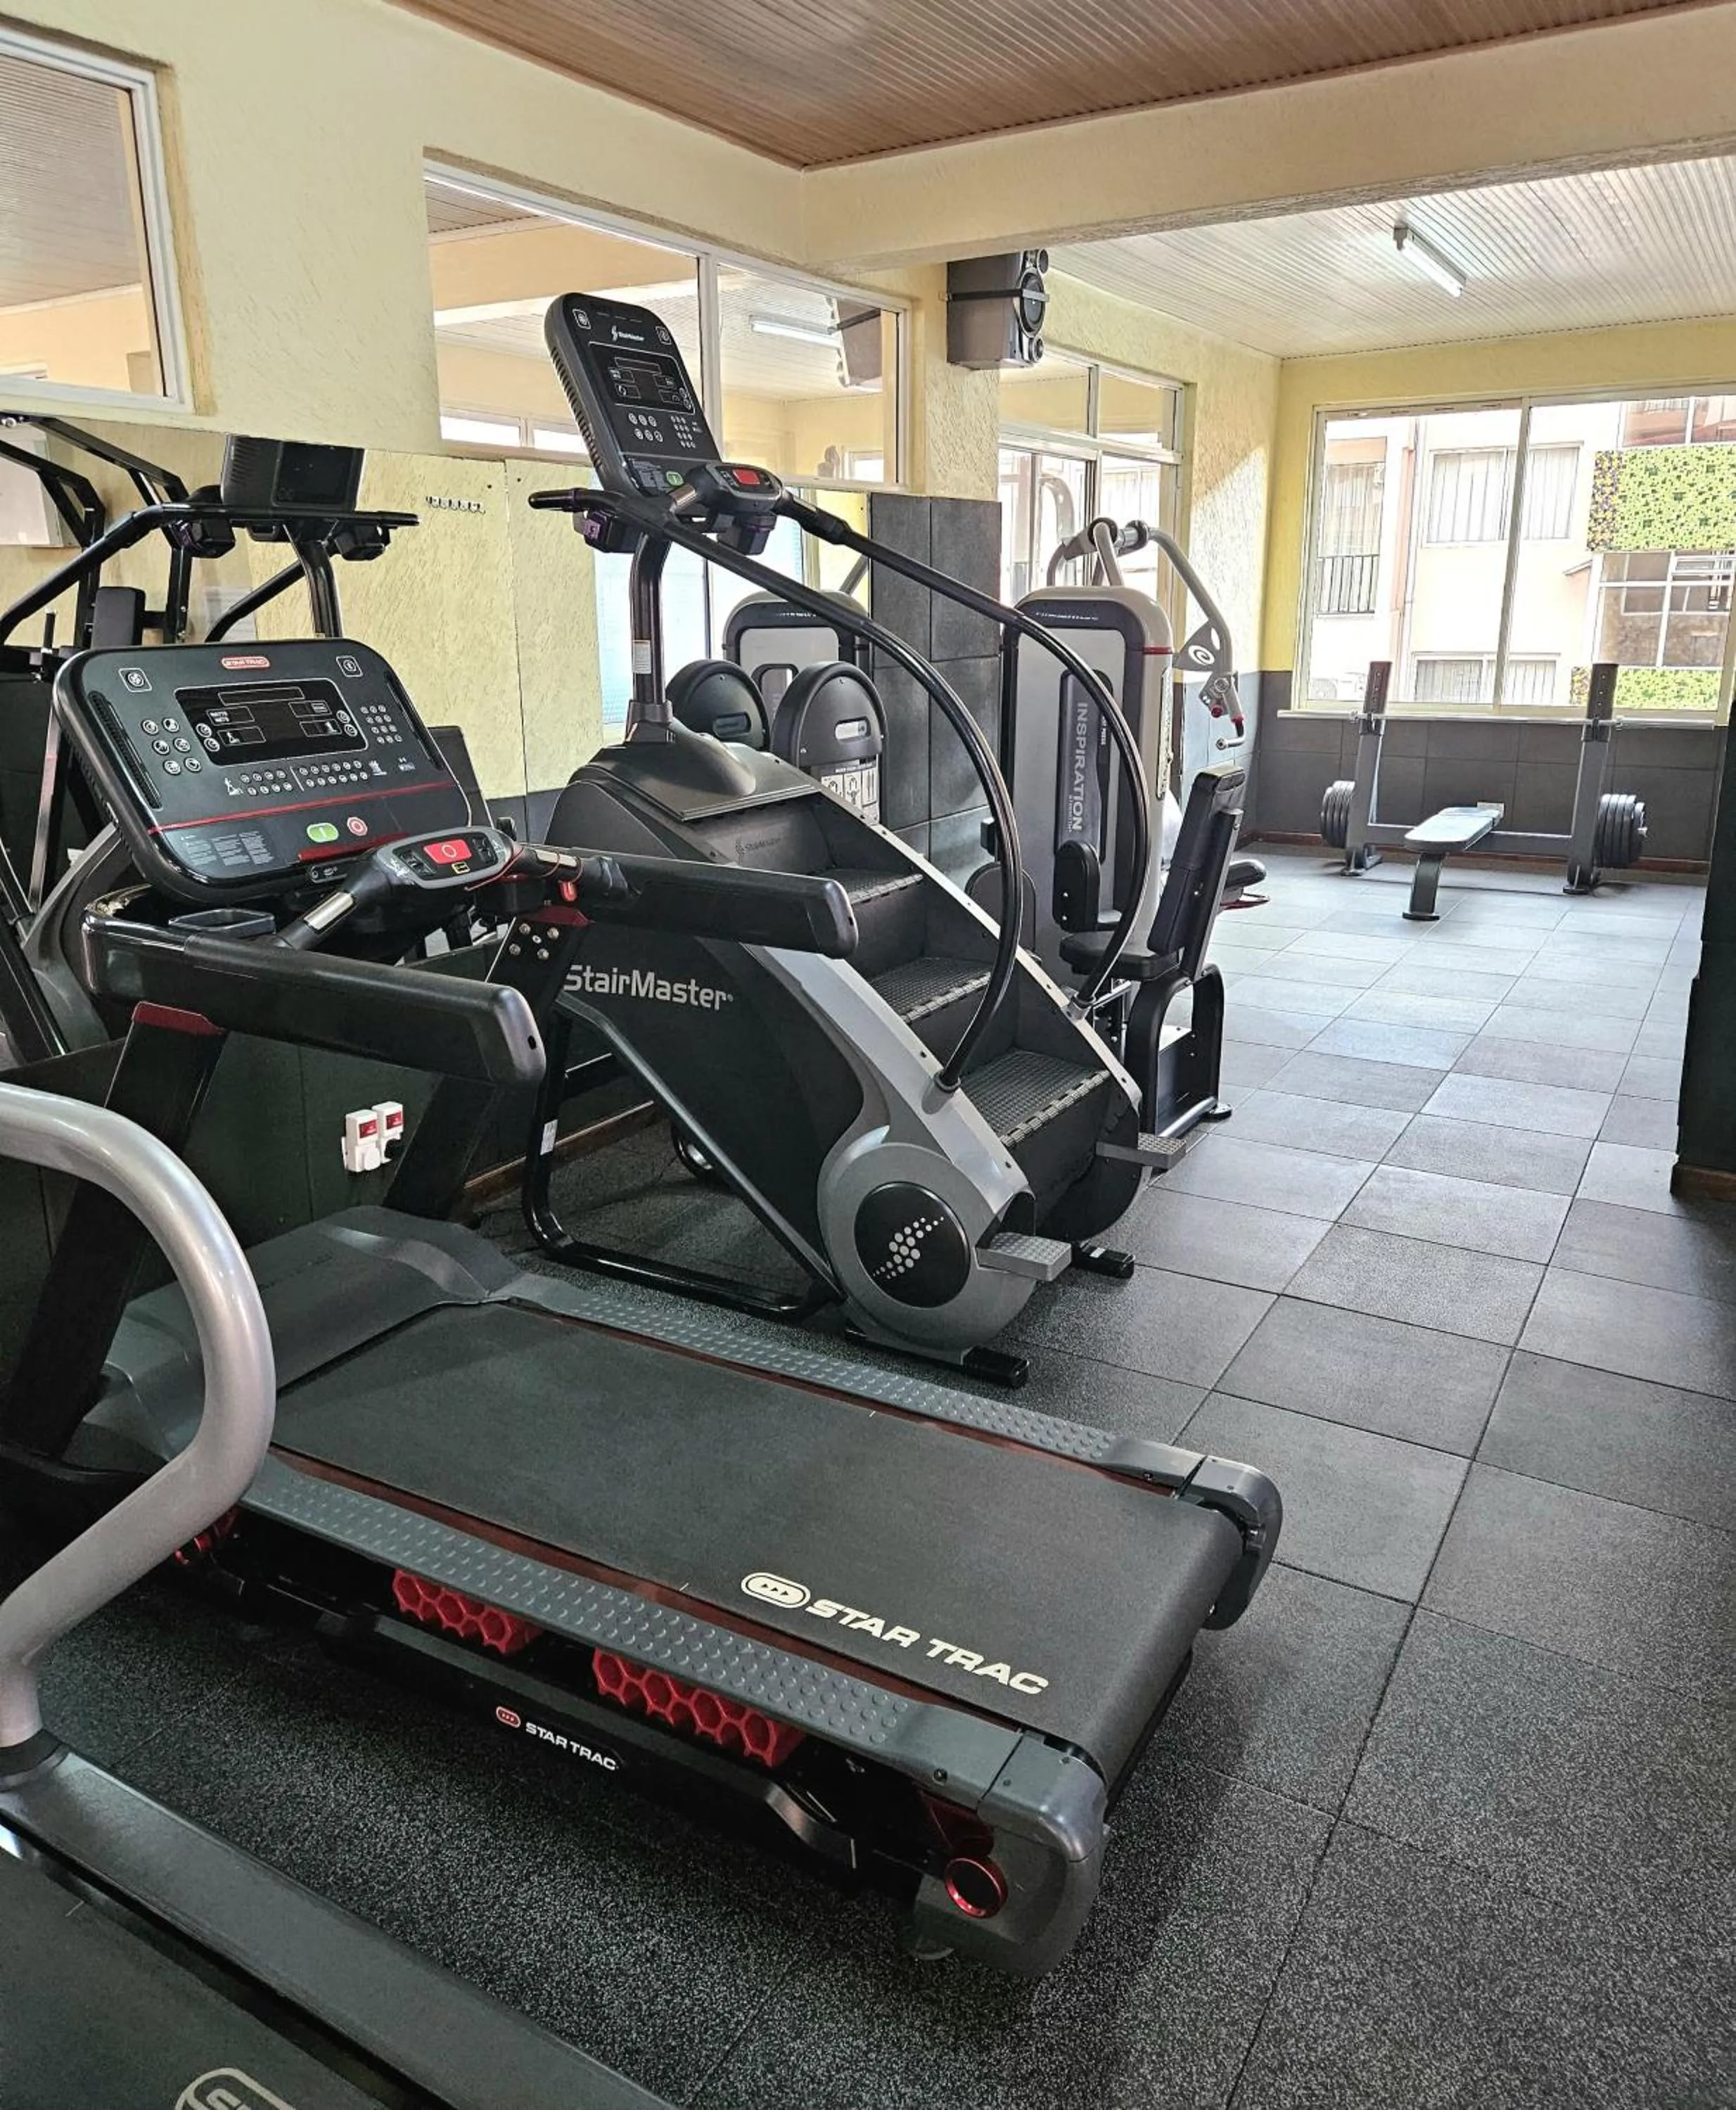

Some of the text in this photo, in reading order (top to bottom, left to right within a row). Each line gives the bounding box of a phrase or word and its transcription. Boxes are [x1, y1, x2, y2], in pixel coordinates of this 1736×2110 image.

[1072, 703, 1088, 831] INSPIRATION
[804, 1599, 1049, 1694] STAR TRAC
[525, 1722, 616, 1771] STAR TRAC
